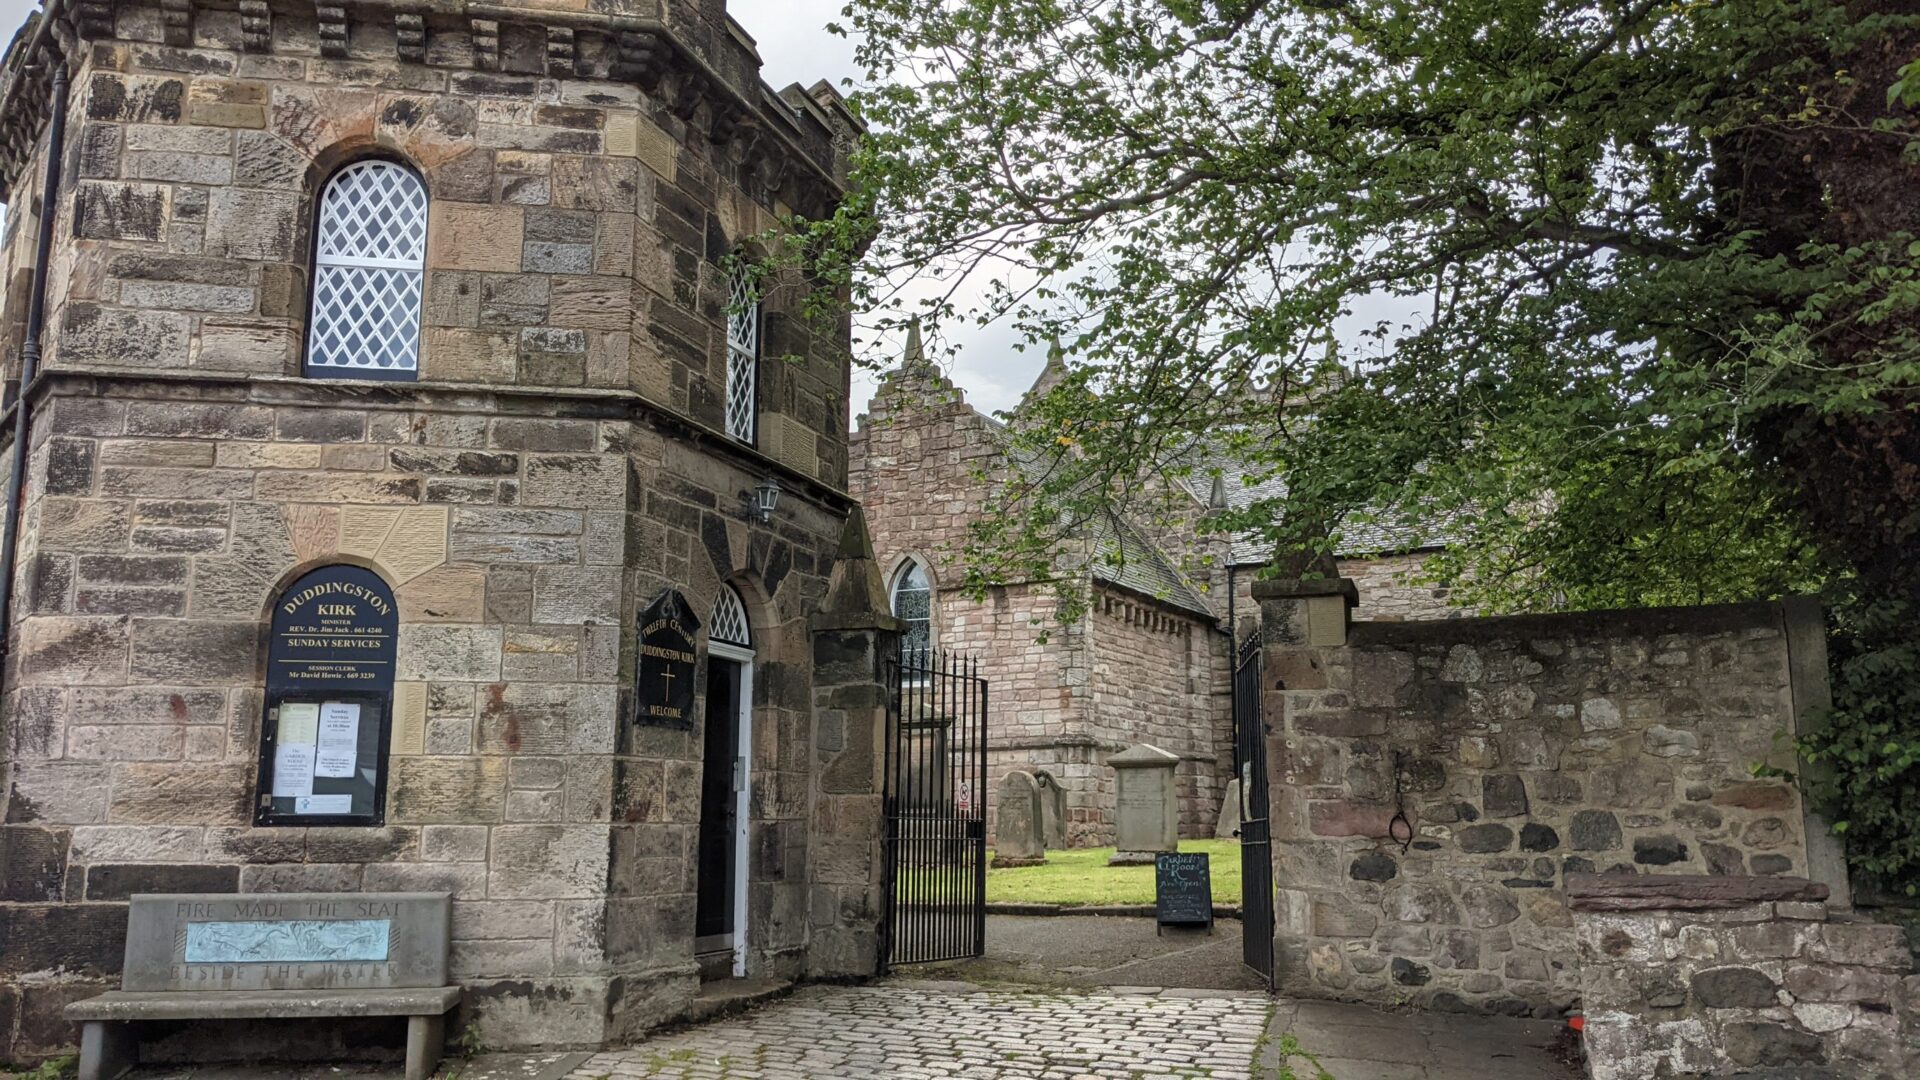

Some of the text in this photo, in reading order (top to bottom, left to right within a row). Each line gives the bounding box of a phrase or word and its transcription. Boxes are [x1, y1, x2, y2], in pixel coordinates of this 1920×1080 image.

[283, 582, 391, 616] DUDDINGSTON
[318, 604, 356, 616] KIRK
[642, 618, 697, 648] TWELFTH CENTURY
[288, 639, 381, 648] SUNDAY SERVICES
[640, 644, 696, 664] DUDDINGSTON KIRK
[650, 705, 682, 718] WELCOME
[176, 902, 402, 918] FIRE MADE THE SEAT
[170, 963, 399, 981] BESIDE THE WATER
